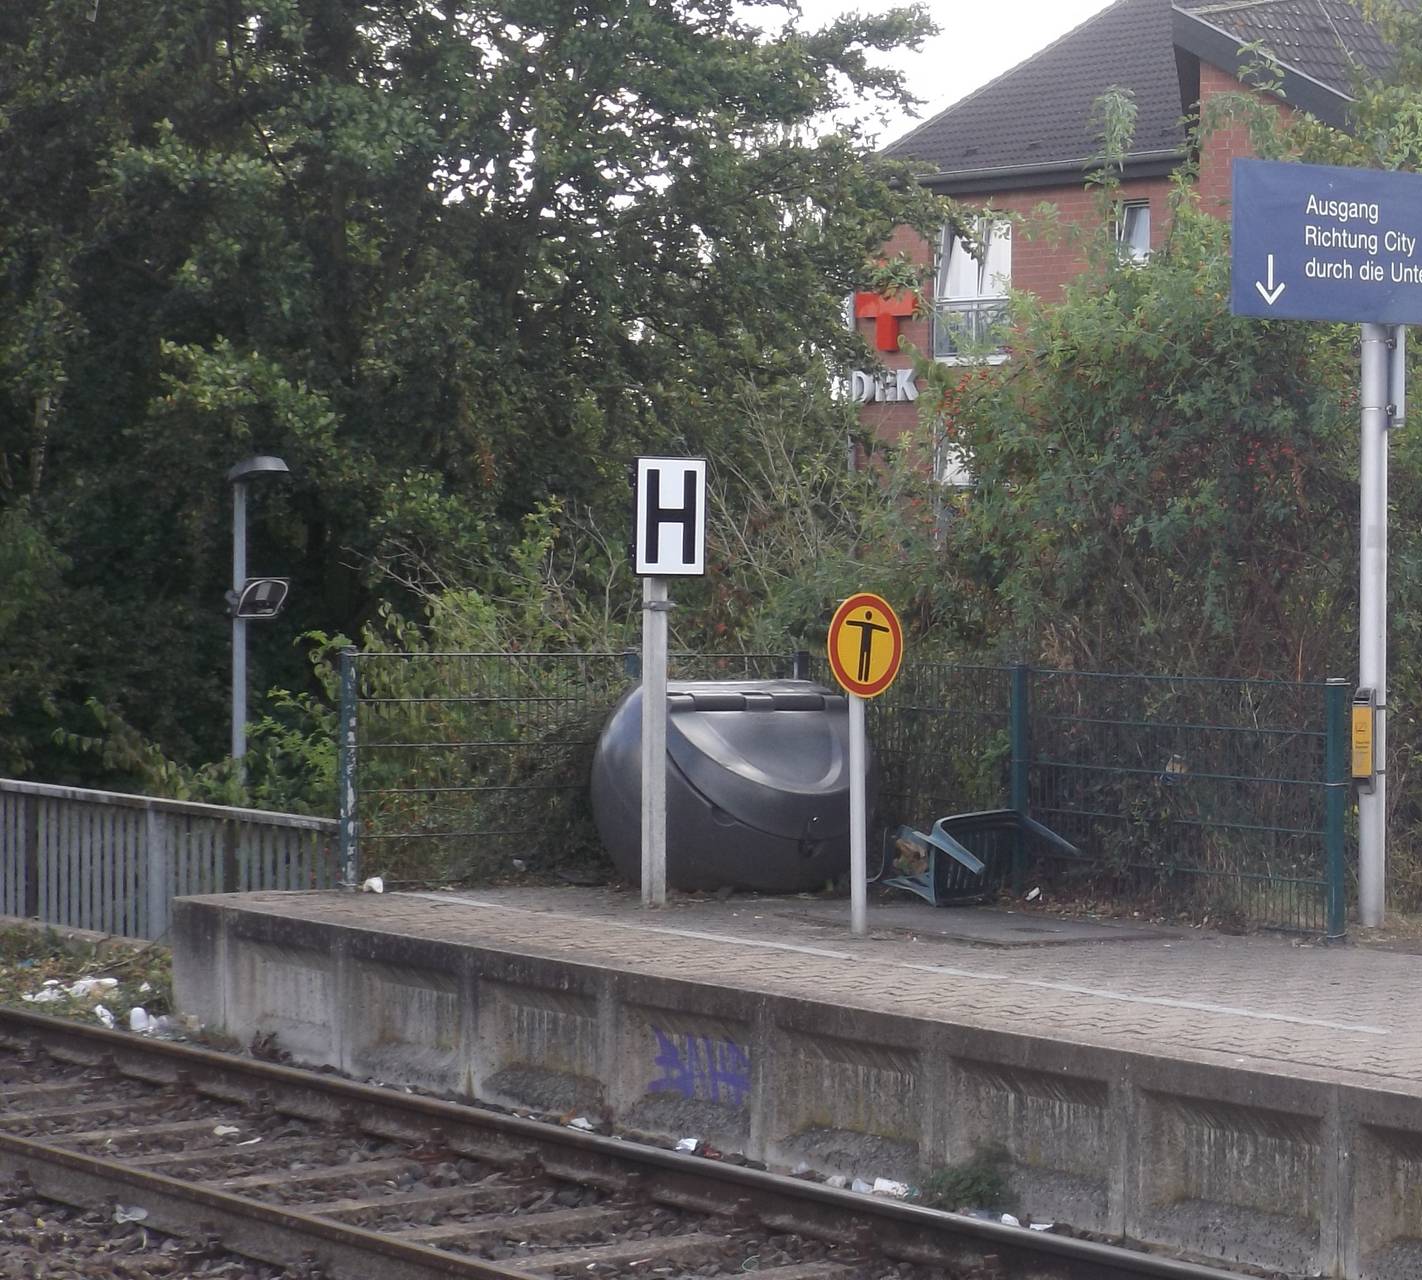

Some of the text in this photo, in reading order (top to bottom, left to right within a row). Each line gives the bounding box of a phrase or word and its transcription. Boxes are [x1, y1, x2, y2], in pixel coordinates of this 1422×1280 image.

[1306, 194, 1379, 224] Ausgang
[1305, 225, 1416, 257] Richtung City
[1305, 257, 1353, 280] durch
[1359, 260, 1384, 281] die
[645, 469, 697, 564] H
